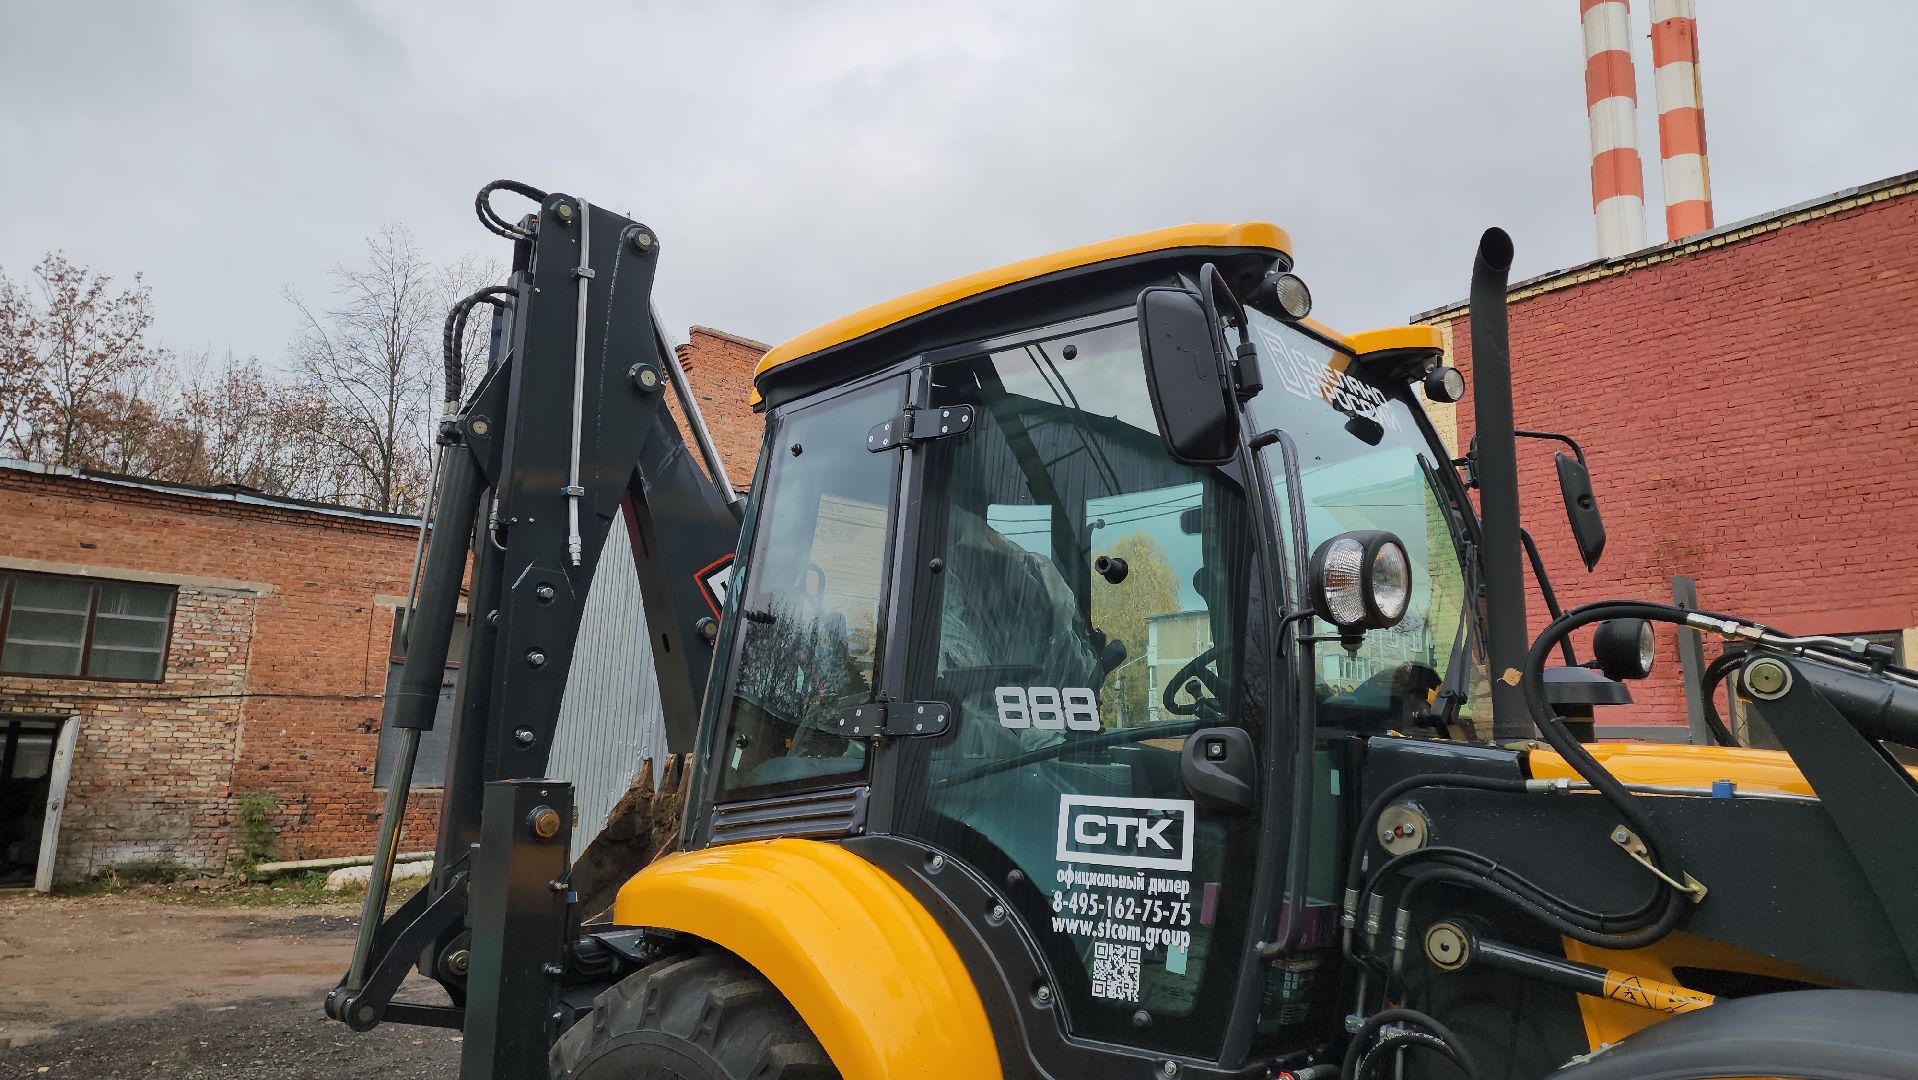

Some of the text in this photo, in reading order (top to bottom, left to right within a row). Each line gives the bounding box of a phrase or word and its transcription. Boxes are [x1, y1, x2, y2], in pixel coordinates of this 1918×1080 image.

[1291, 349, 1388, 405] СДЕЛАНО
[995, 686, 1100, 731] 888
[1074, 814, 1174, 850] СТК
[1056, 865, 1190, 900] официальный дилер
[1052, 891, 1191, 927] 8-495-162-75-75
[1051, 915, 1191, 954] www.stcom.group
